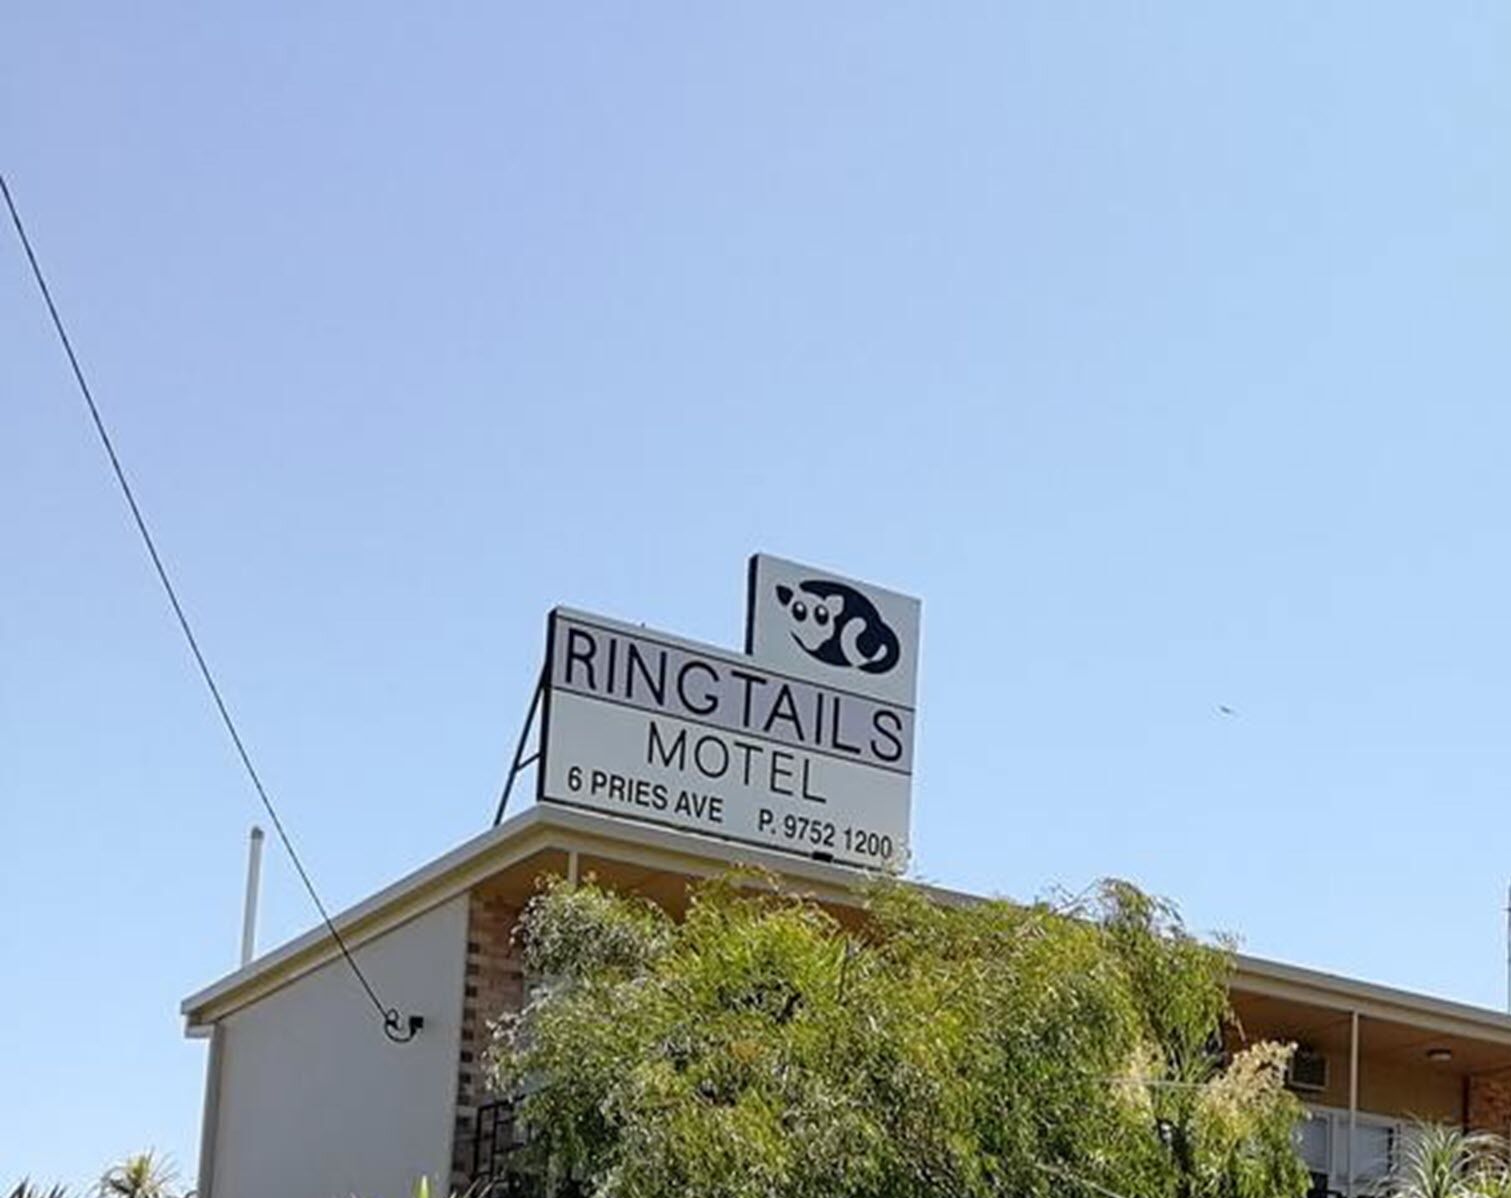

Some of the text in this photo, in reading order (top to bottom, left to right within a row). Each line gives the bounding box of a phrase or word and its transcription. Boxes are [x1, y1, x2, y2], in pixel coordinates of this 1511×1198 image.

[565, 628, 904, 763] RINGTAILS
[646, 721, 827, 804] MOTEL
[567, 766, 893, 861] 6 PRIES AVE P. 9752 1200
